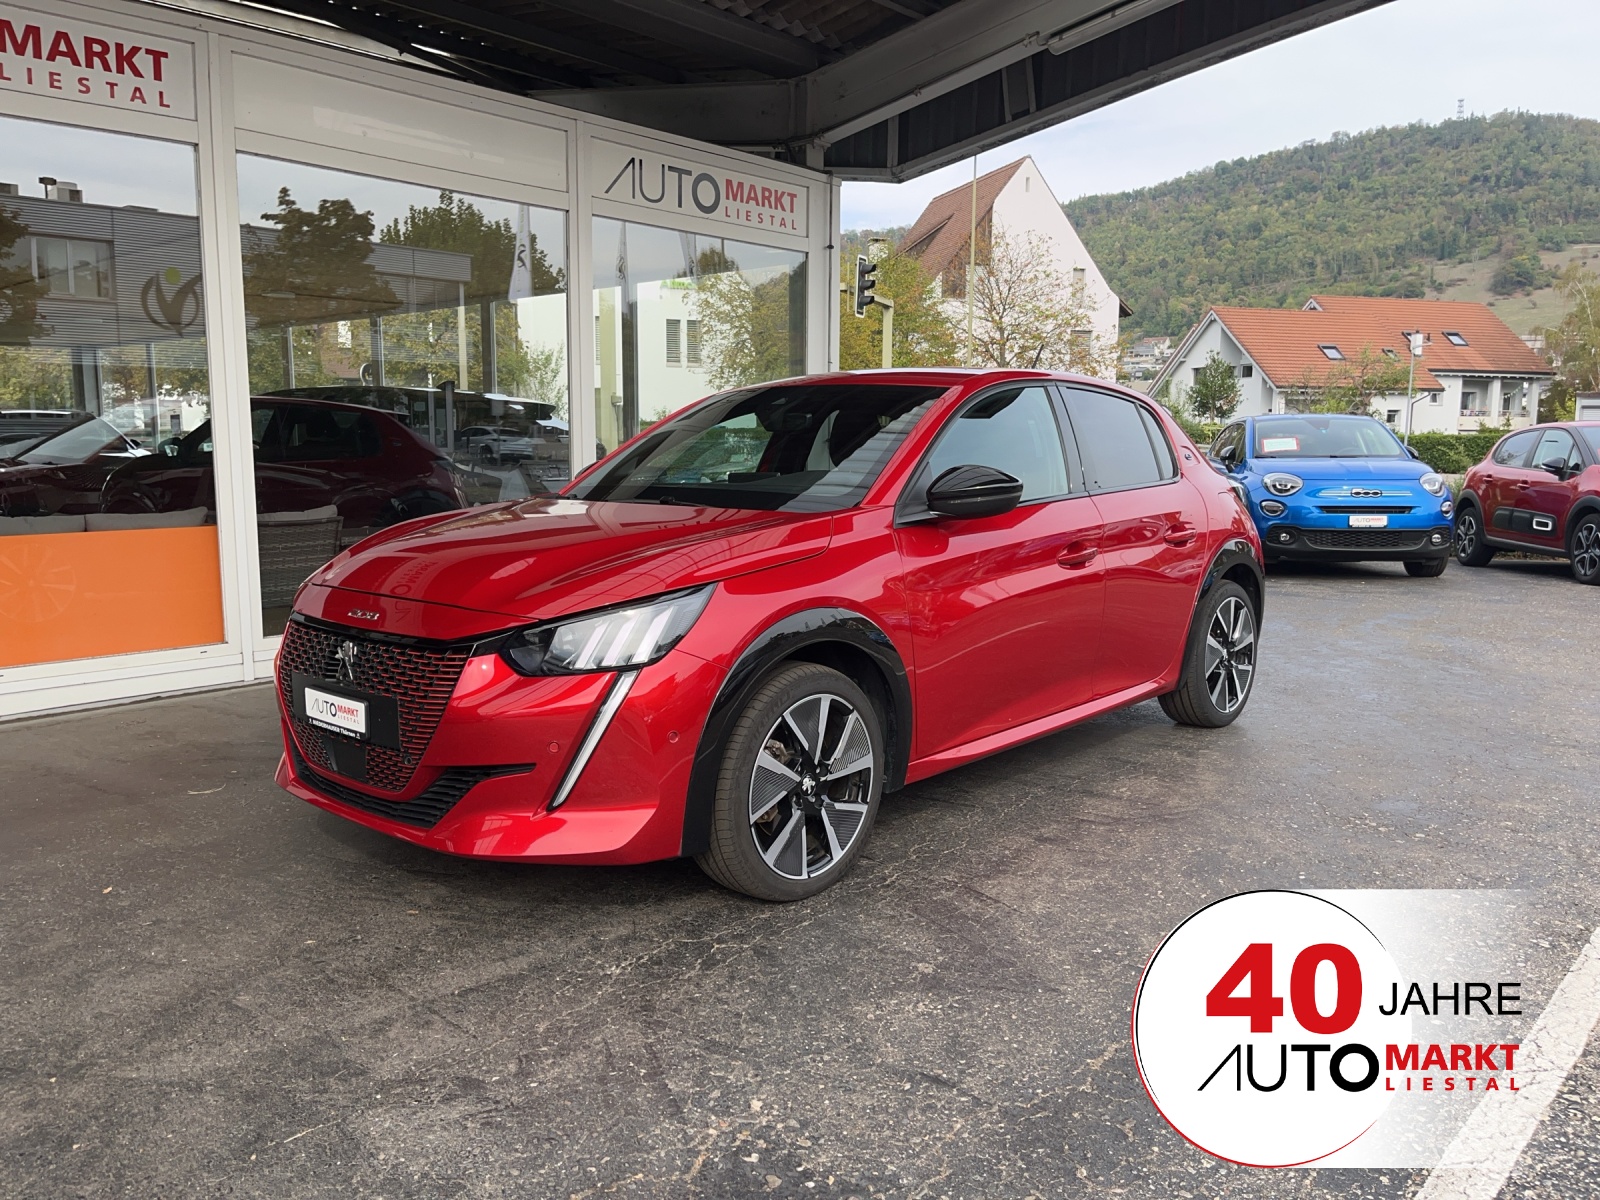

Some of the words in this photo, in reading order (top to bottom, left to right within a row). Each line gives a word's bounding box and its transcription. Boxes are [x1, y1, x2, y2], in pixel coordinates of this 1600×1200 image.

[0, 19, 168, 82] MARKT
[0, 63, 170, 109] LIESTAL
[604, 157, 720, 214] AUTO
[725, 179, 797, 213] MARKT
[725, 206, 797, 230] LIESTAL
[1351, 488, 1382, 498] 500
[311, 698, 337, 717] AUTO
[337, 704, 359, 718] MARKT
[337, 714, 360, 724] LIESTAL
